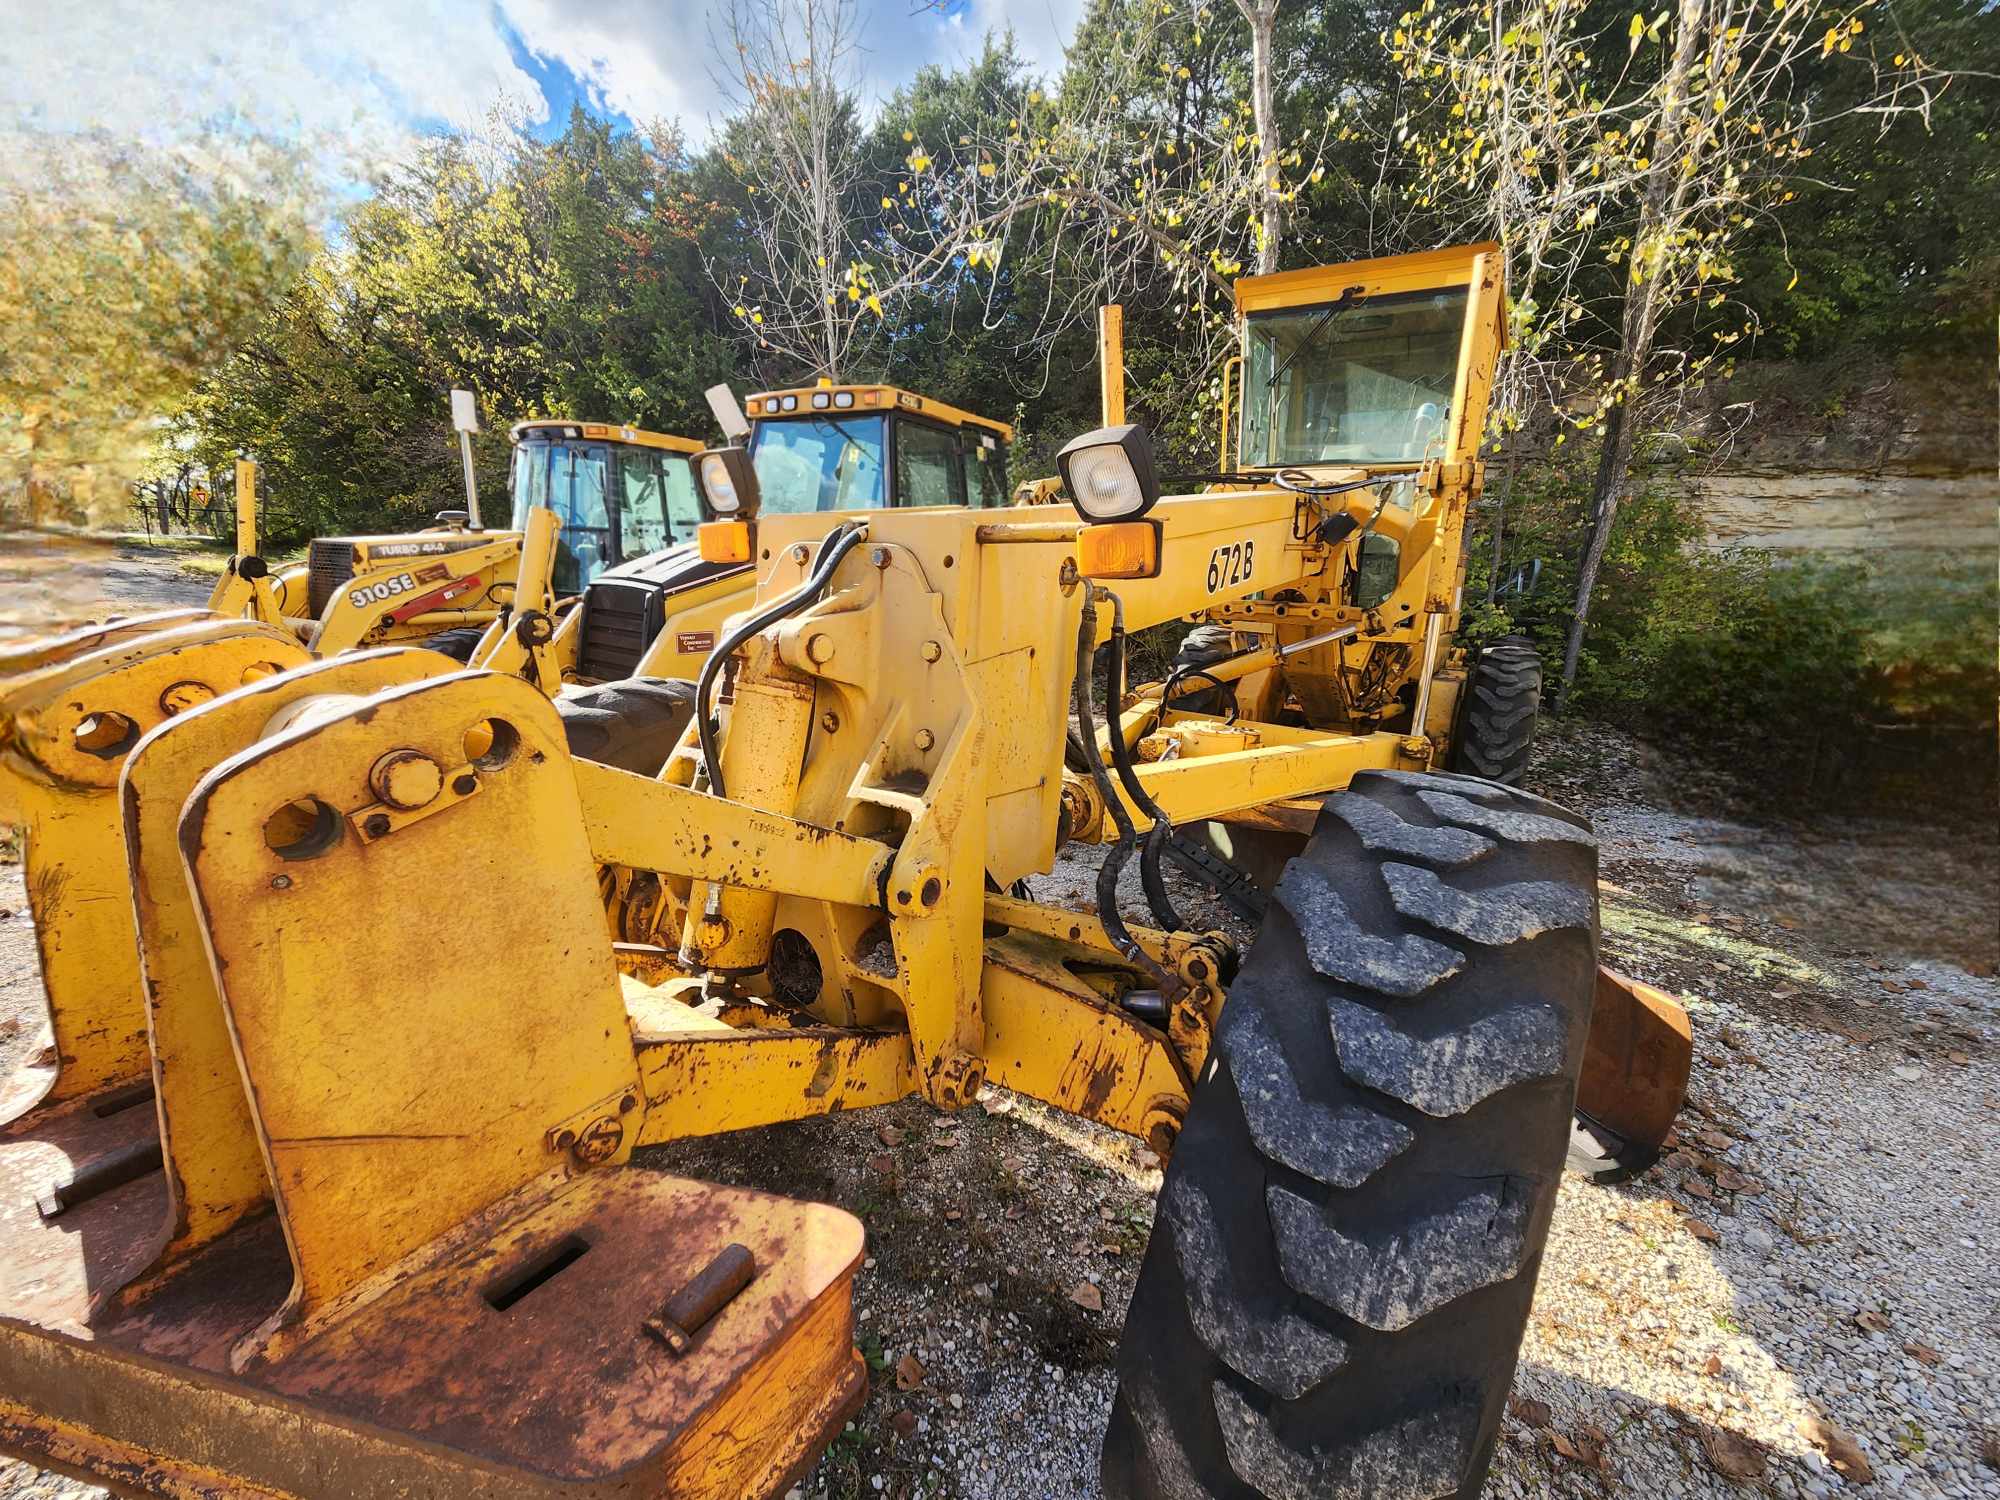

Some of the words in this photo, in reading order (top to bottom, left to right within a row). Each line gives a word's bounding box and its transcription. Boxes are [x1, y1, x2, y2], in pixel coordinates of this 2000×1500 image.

[378, 544, 419, 555] TURBO
[1206, 540, 1255, 595] 672B
[349, 573, 416, 608] 310SE
